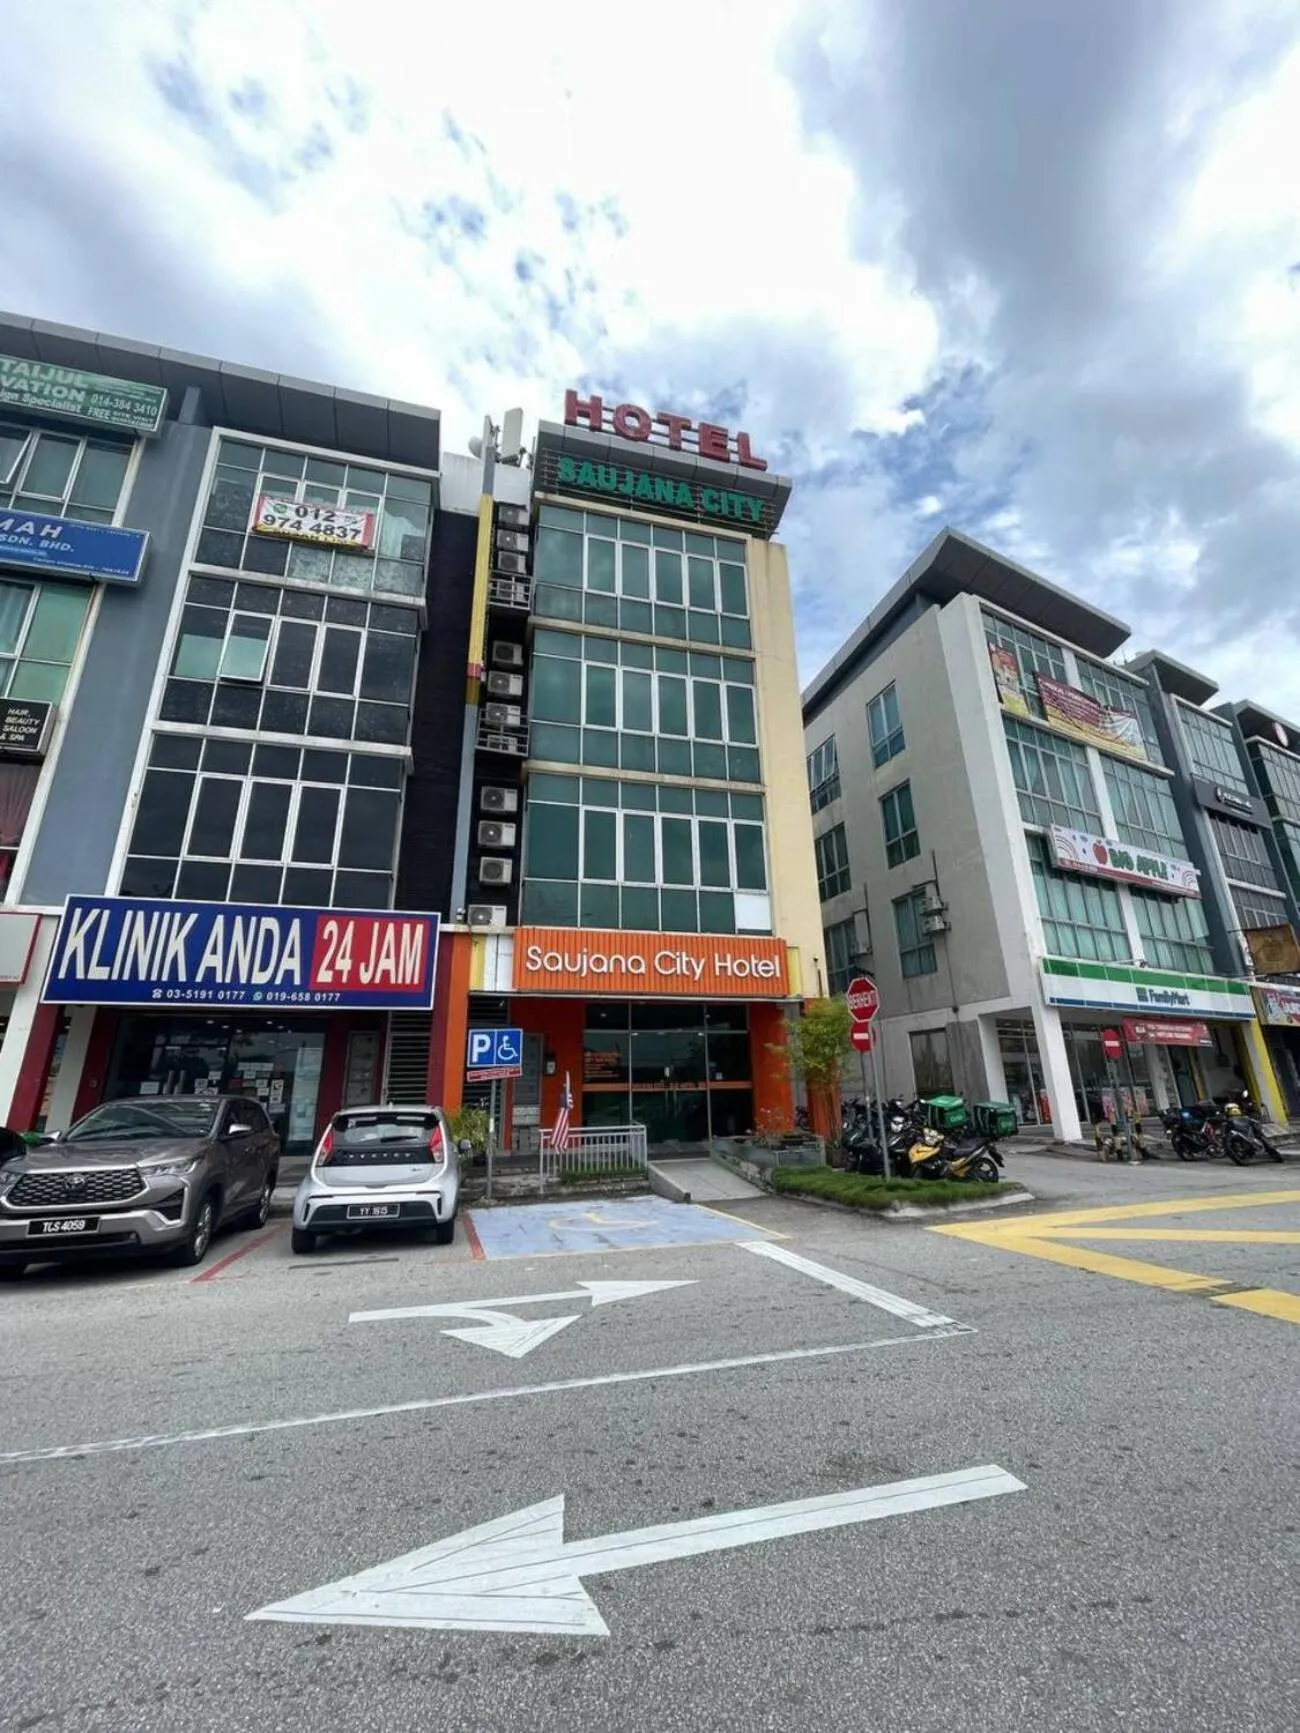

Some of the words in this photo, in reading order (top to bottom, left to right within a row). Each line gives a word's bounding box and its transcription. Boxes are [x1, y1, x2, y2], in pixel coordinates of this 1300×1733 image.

[564, 389, 767, 471] HOTEL
[557, 455, 694, 510] SAUJANA
[702, 488, 765, 523] CITY
[295, 505, 336, 523] 012
[263, 514, 302, 531] 974
[309, 523, 360, 540] 4837
[40, 540, 74, 552] BHD.
[5, 716, 40, 726] BEAUTY
[1108, 847, 1135, 872] BIG
[58, 907, 199, 982] KLINIK
[195, 914, 301, 986] ANDA
[316, 920, 354, 984] 24
[359, 921, 424, 985] JAM
[526, 945, 646, 977] Saujana
[654, 950, 705, 981] City
[714, 952, 781, 978] Hotel
[166, 989, 213, 999] 03-5191
[218, 989, 245, 1000] 0177
[266, 991, 311, 1001] 019-658
[314, 992, 341, 1002] 0177
[471, 1033, 491, 1063] P
[43, 1221, 61, 1233] TLS
